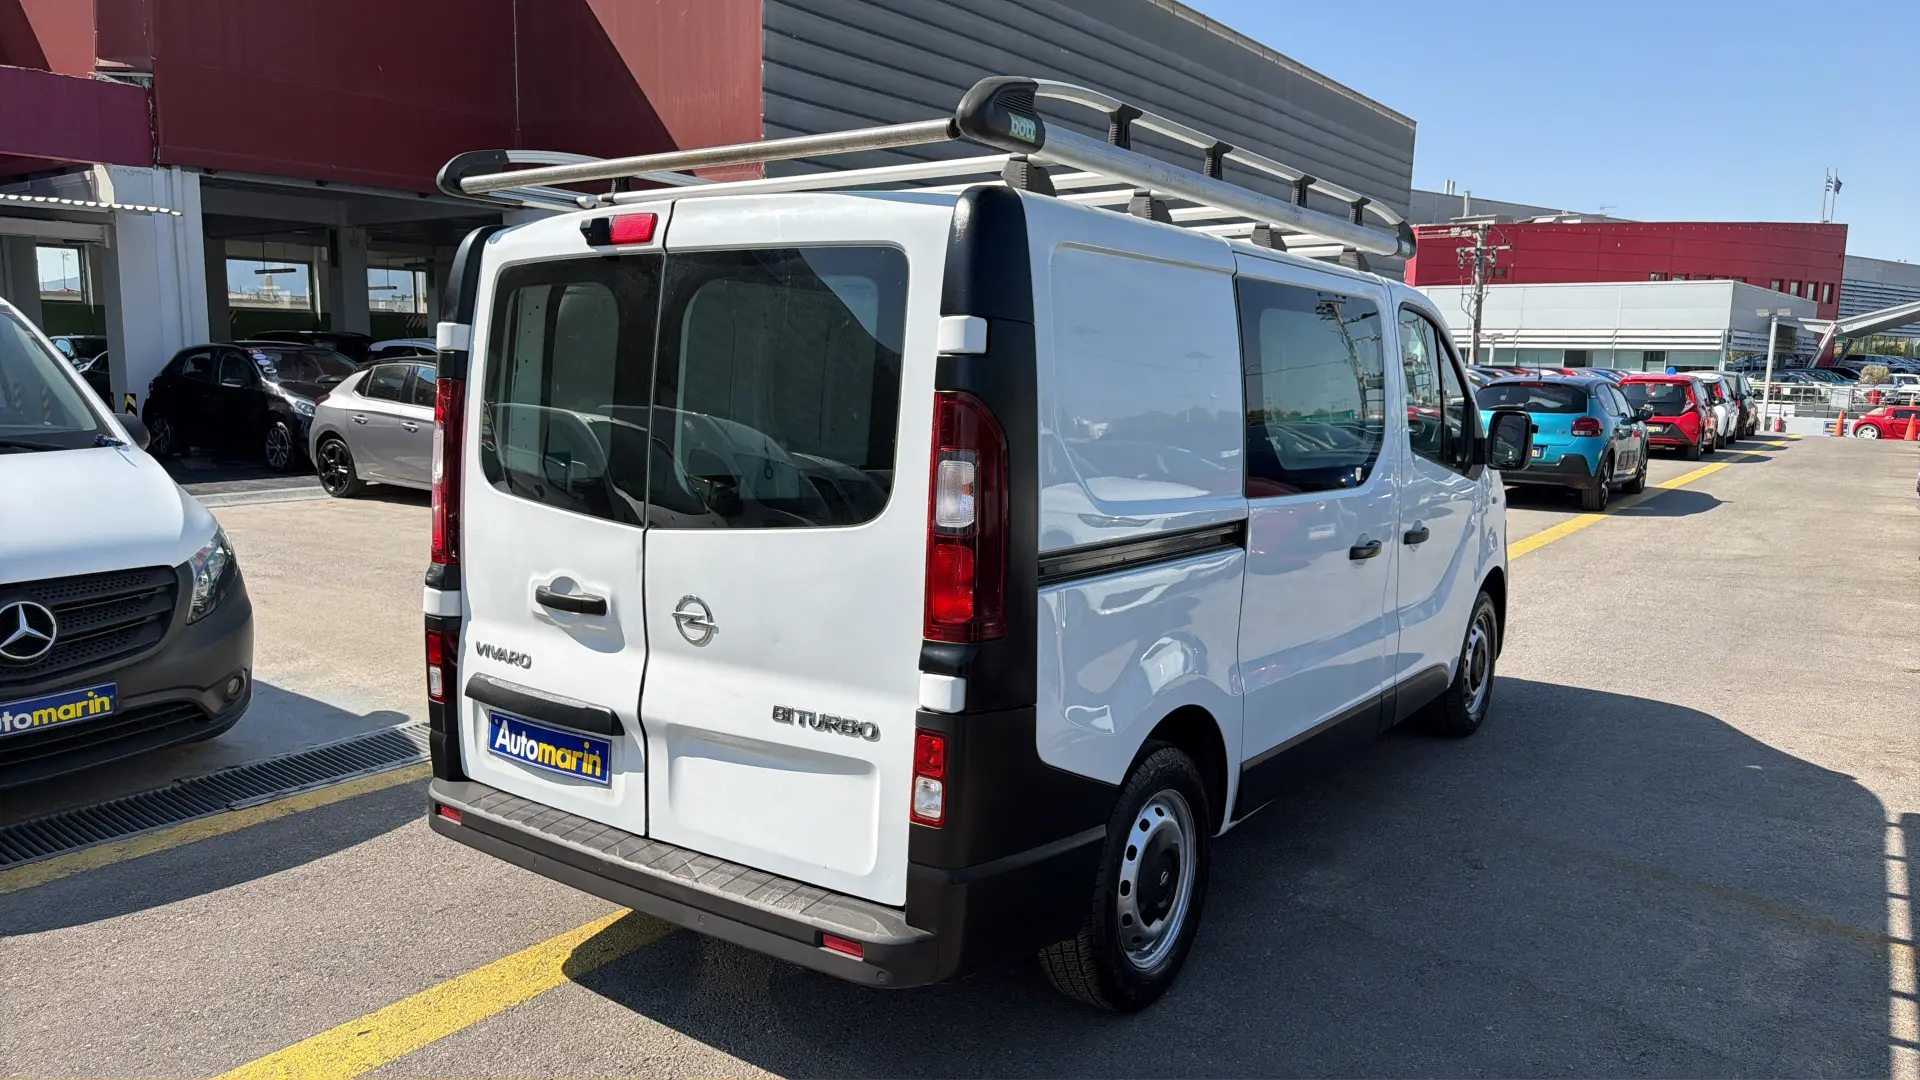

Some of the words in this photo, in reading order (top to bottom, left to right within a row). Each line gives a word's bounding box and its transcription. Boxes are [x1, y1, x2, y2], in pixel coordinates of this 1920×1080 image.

[475, 641, 532, 670] VIVARO
[0, 691, 111, 732] tomarin
[772, 704, 881, 742] BITURBO
[494, 719, 602, 777] Automarin
